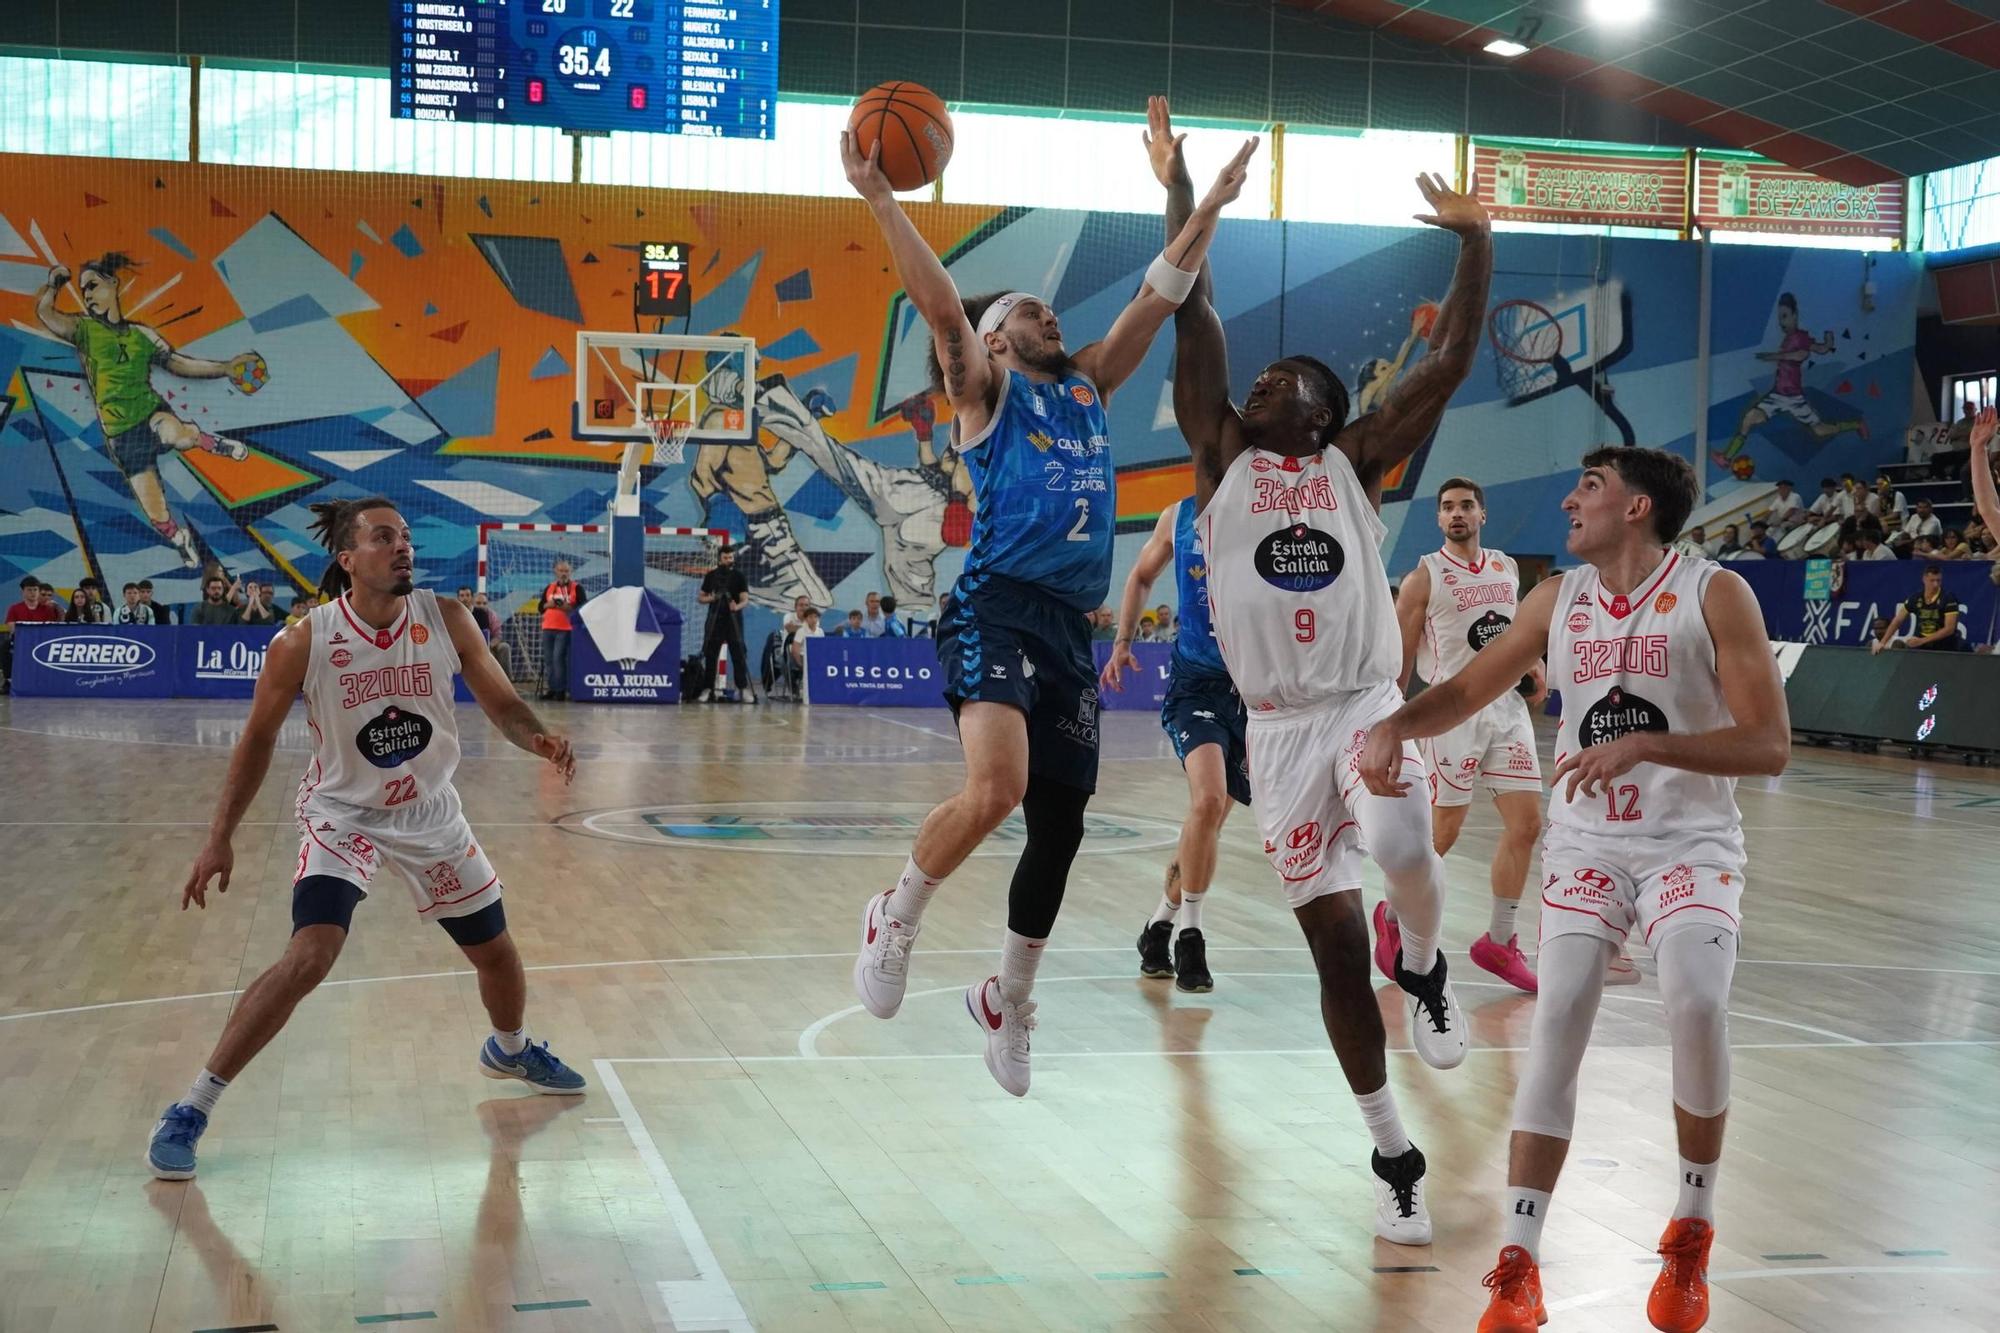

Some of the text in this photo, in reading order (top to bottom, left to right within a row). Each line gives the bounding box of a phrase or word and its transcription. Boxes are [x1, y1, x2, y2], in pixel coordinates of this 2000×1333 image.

[403, 3, 413, 13] 13
[459, 6, 465, 17] A
[542, 0, 566, 13] 20
[610, 0, 634, 18] 22
[669, 6, 677, 16] 11
[403, 18, 413, 28] 14
[669, 21, 678, 31] 12
[582, 30, 597, 47] 1Q
[667, 35, 677, 45] 22
[761, 41, 768, 52] 2
[403, 48, 412, 58] 17
[453, 50, 460, 61] T
[559, 45, 611, 77] 35.4
[401, 63, 411, 73] 21
[415, 63, 432, 75] VAN
[469, 67, 474, 78] J
[498, 68, 505, 79] 7
[666, 65, 677, 75] 24
[731, 68, 737, 79] S
[401, 78, 411, 88] 34
[472, 81, 479, 93] S
[666, 80, 676, 90] 27
[452, 95, 457, 106] J
[401, 108, 411, 118] 78
[449, 110, 455, 121] A
[760, 114, 766, 125] 2
[665, 124, 675, 133] 41
[760, 129, 766, 139] 4
[1537, 168, 1662, 190] AYUNTAMIENTO
[1536, 185, 1661, 211] DE ZAMORA
[1757, 195, 1879, 220] DE ZAMORA
[1819, 226, 1875, 234] DEPORTES
[645, 244, 679, 260] 35.4
[646, 271, 683, 299] 17
[1058, 438, 1086, 450] CAJA
[1067, 498, 1091, 541] 2
[1271, 540, 1329, 556] Estrella
[1273, 556, 1329, 573] Galicia
[1452, 582, 1515, 612] 32005
[1614, 602, 1627, 611] 78
[1295, 608, 1315, 642] 9
[47, 643, 140, 663] FERRERO
[197, 641, 267, 678] La Opi
[827, 665, 931, 679] DISCOLO
[340, 663, 433, 709] 32005
[584, 674, 672, 687] CAJA RURAL
[593, 688, 658, 697] DE ZAMORA
[1591, 708, 1650, 729] Estrella
[369, 721, 421, 742] Estrella
[373, 735, 419, 756] Galicia
[384, 775, 417, 806] 22
[1606, 785, 1642, 821] 12
